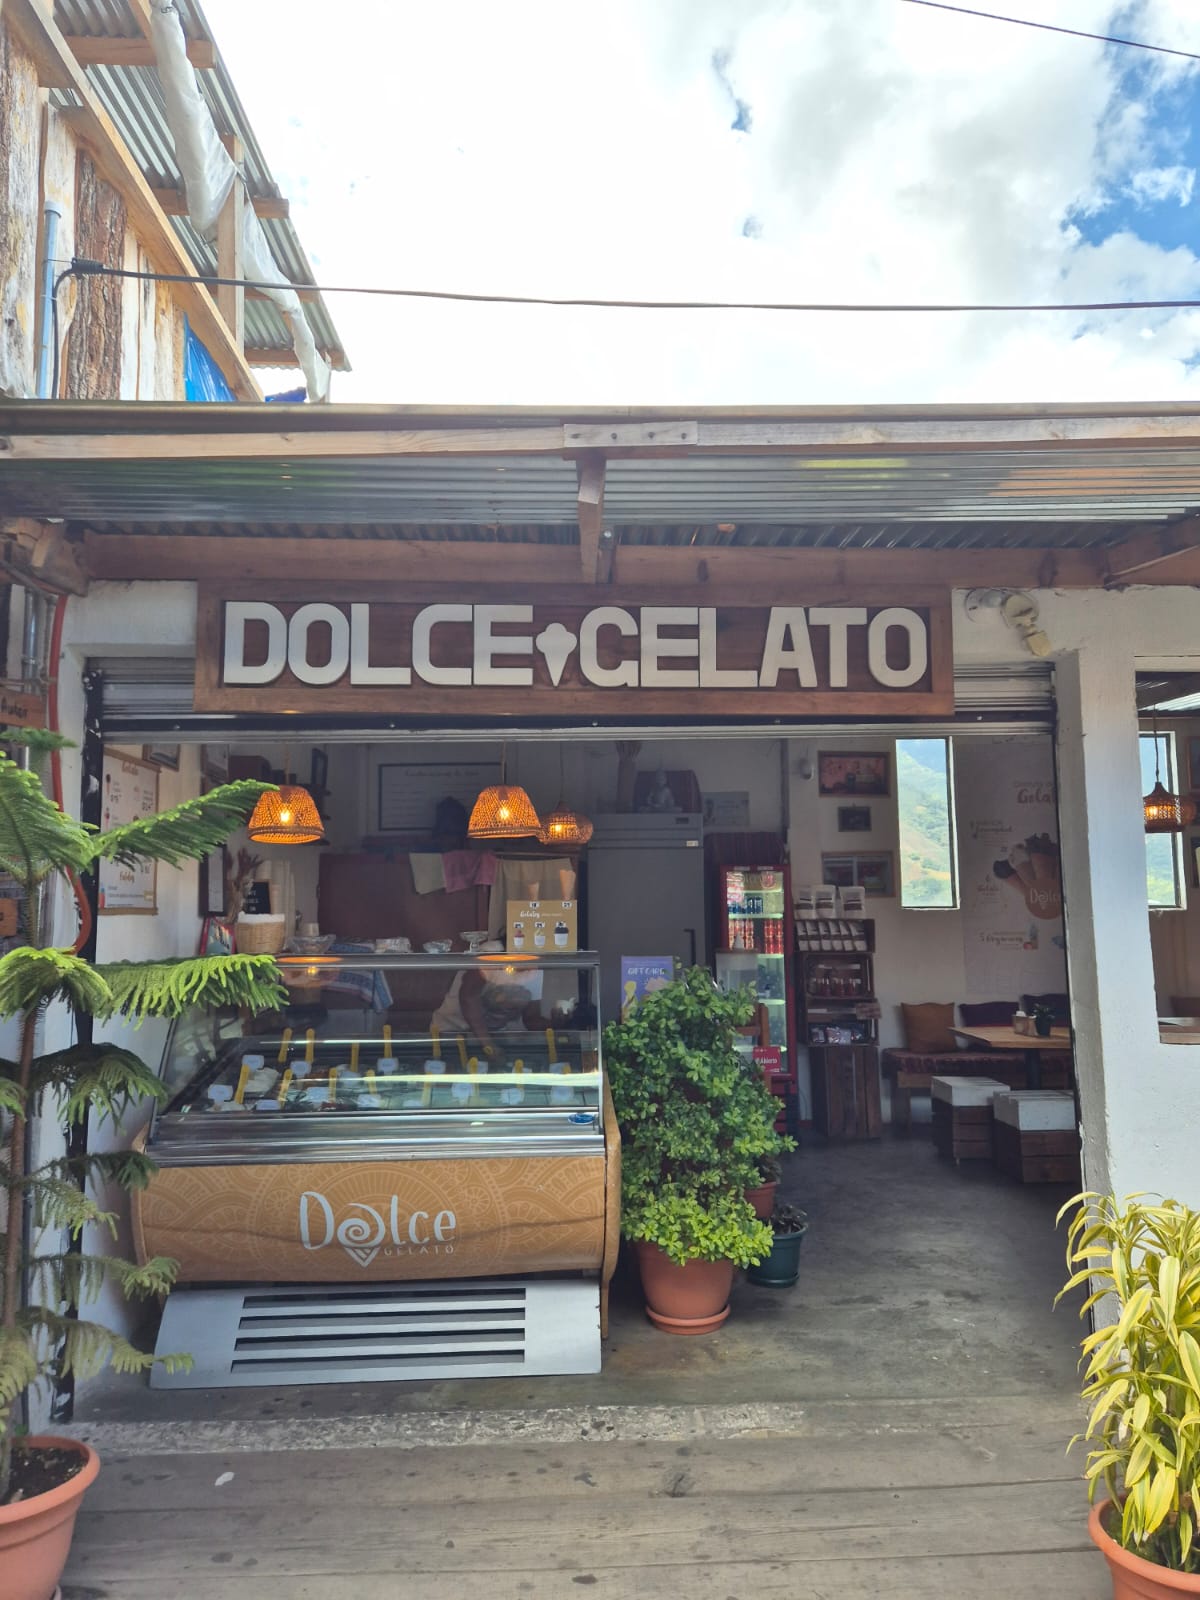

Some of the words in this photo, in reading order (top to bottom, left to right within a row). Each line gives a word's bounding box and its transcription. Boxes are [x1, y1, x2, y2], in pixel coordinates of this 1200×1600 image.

[223, 601, 533, 686] DOLCE
[579, 606, 928, 688] GELATO
[299, 1190, 457, 1252] Dolce
[383, 1244, 455, 1257] GELATO
